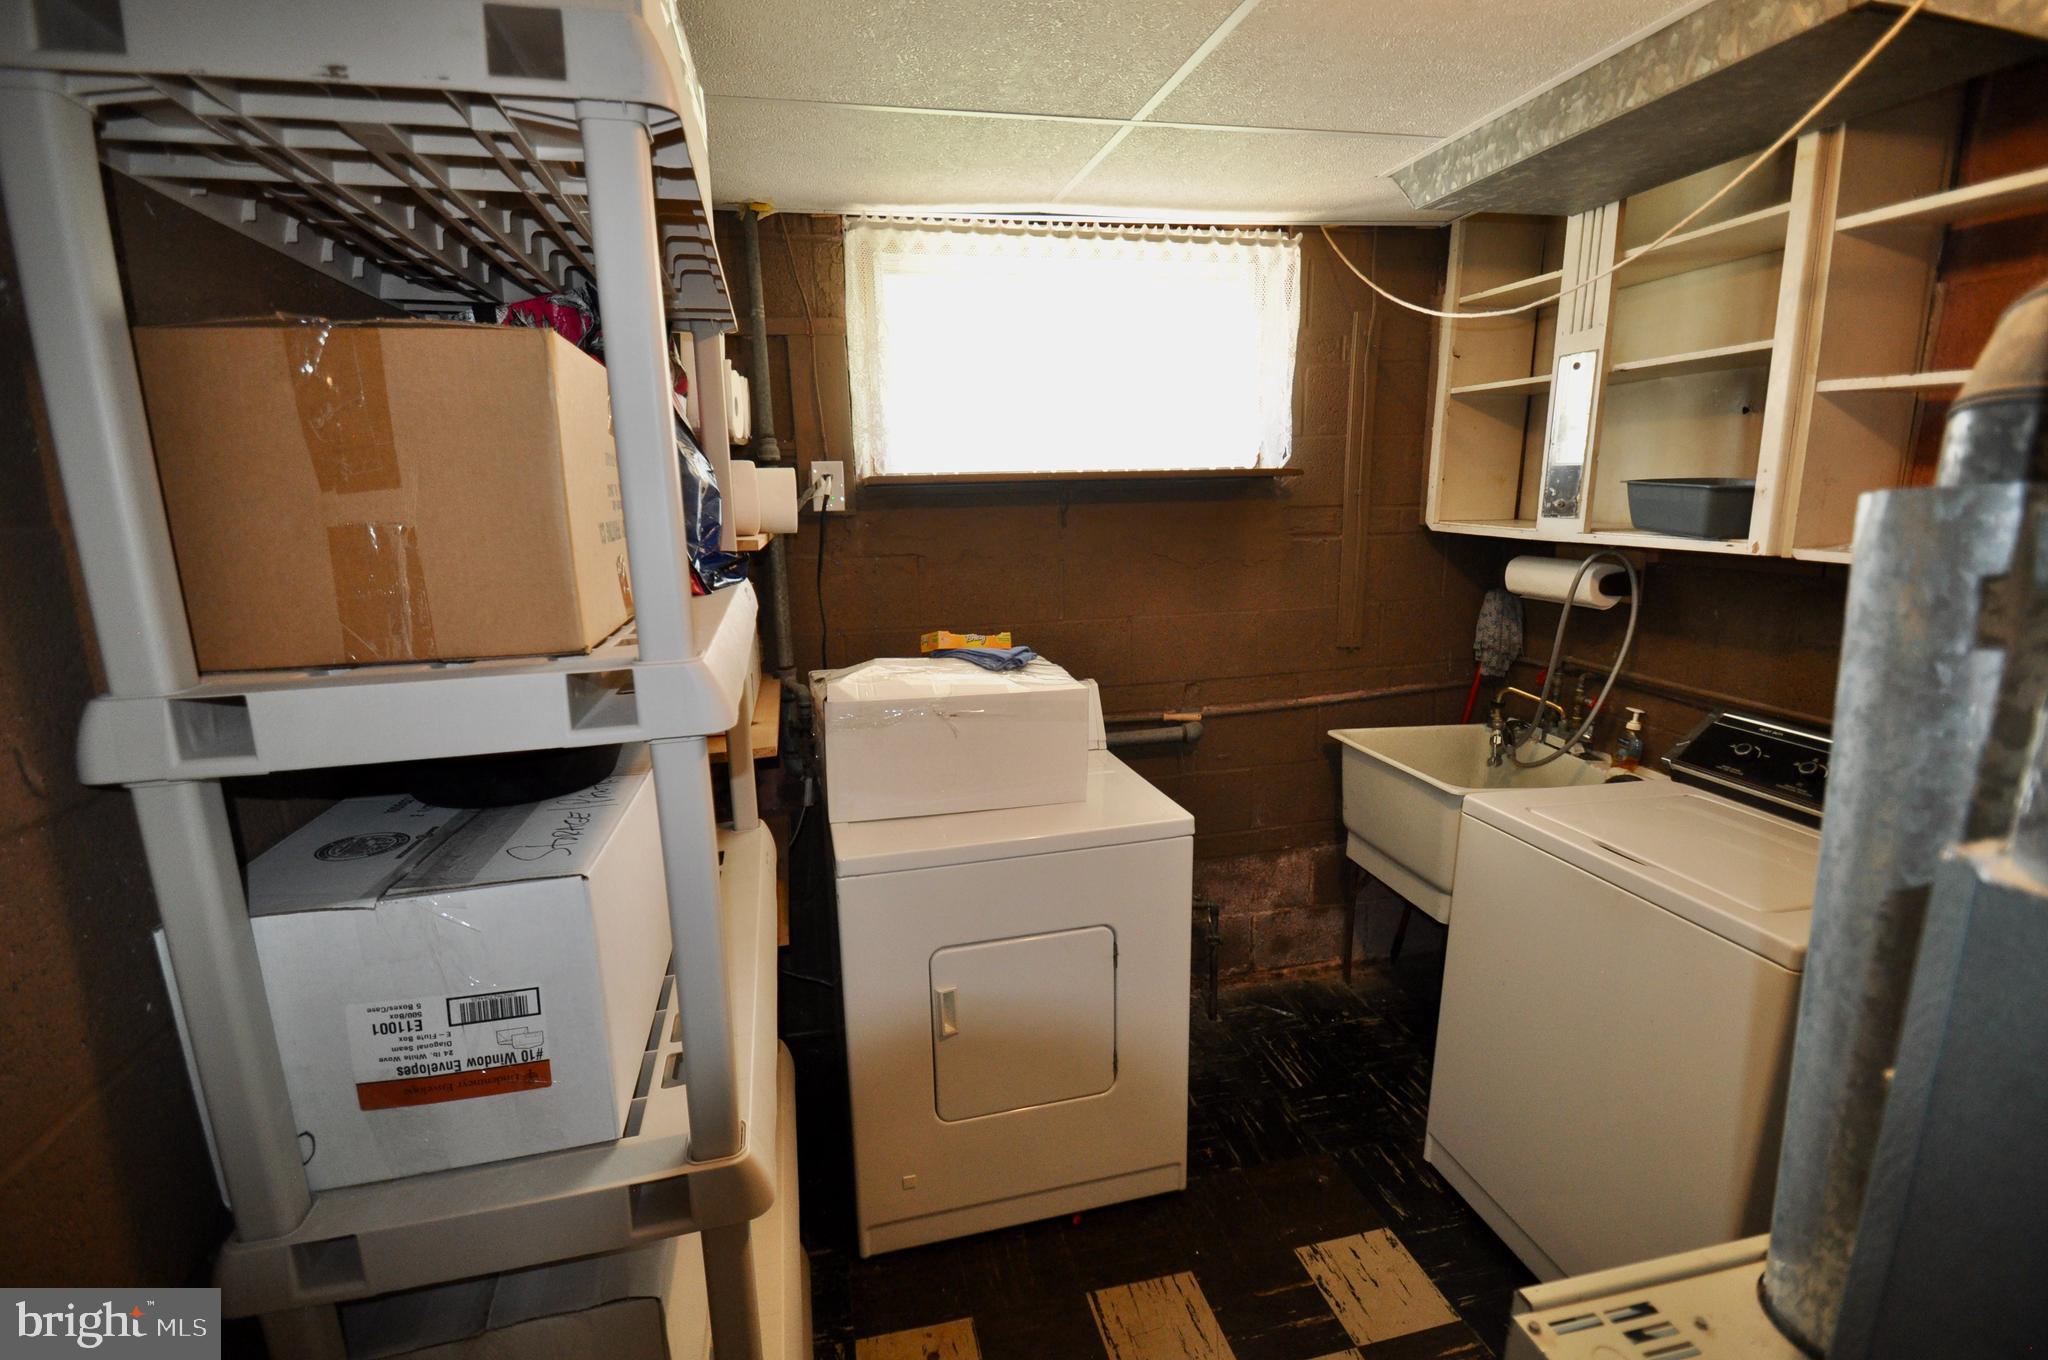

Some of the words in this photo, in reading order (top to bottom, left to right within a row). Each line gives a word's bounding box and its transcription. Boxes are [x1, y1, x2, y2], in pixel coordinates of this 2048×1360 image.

[366, 1003, 414, 1013] Boxes/Case
[389, 1011, 423, 1019] 500/Box
[372, 1019, 423, 1036] E11001
[416, 1040, 453, 1051] Diagonal
[403, 1053, 427, 1061] White
[443, 1049, 454, 1057] 24
[521, 1047, 544, 1062] #10
[466, 1051, 517, 1068] Window
[396, 1059, 462, 1076] Envelopes
